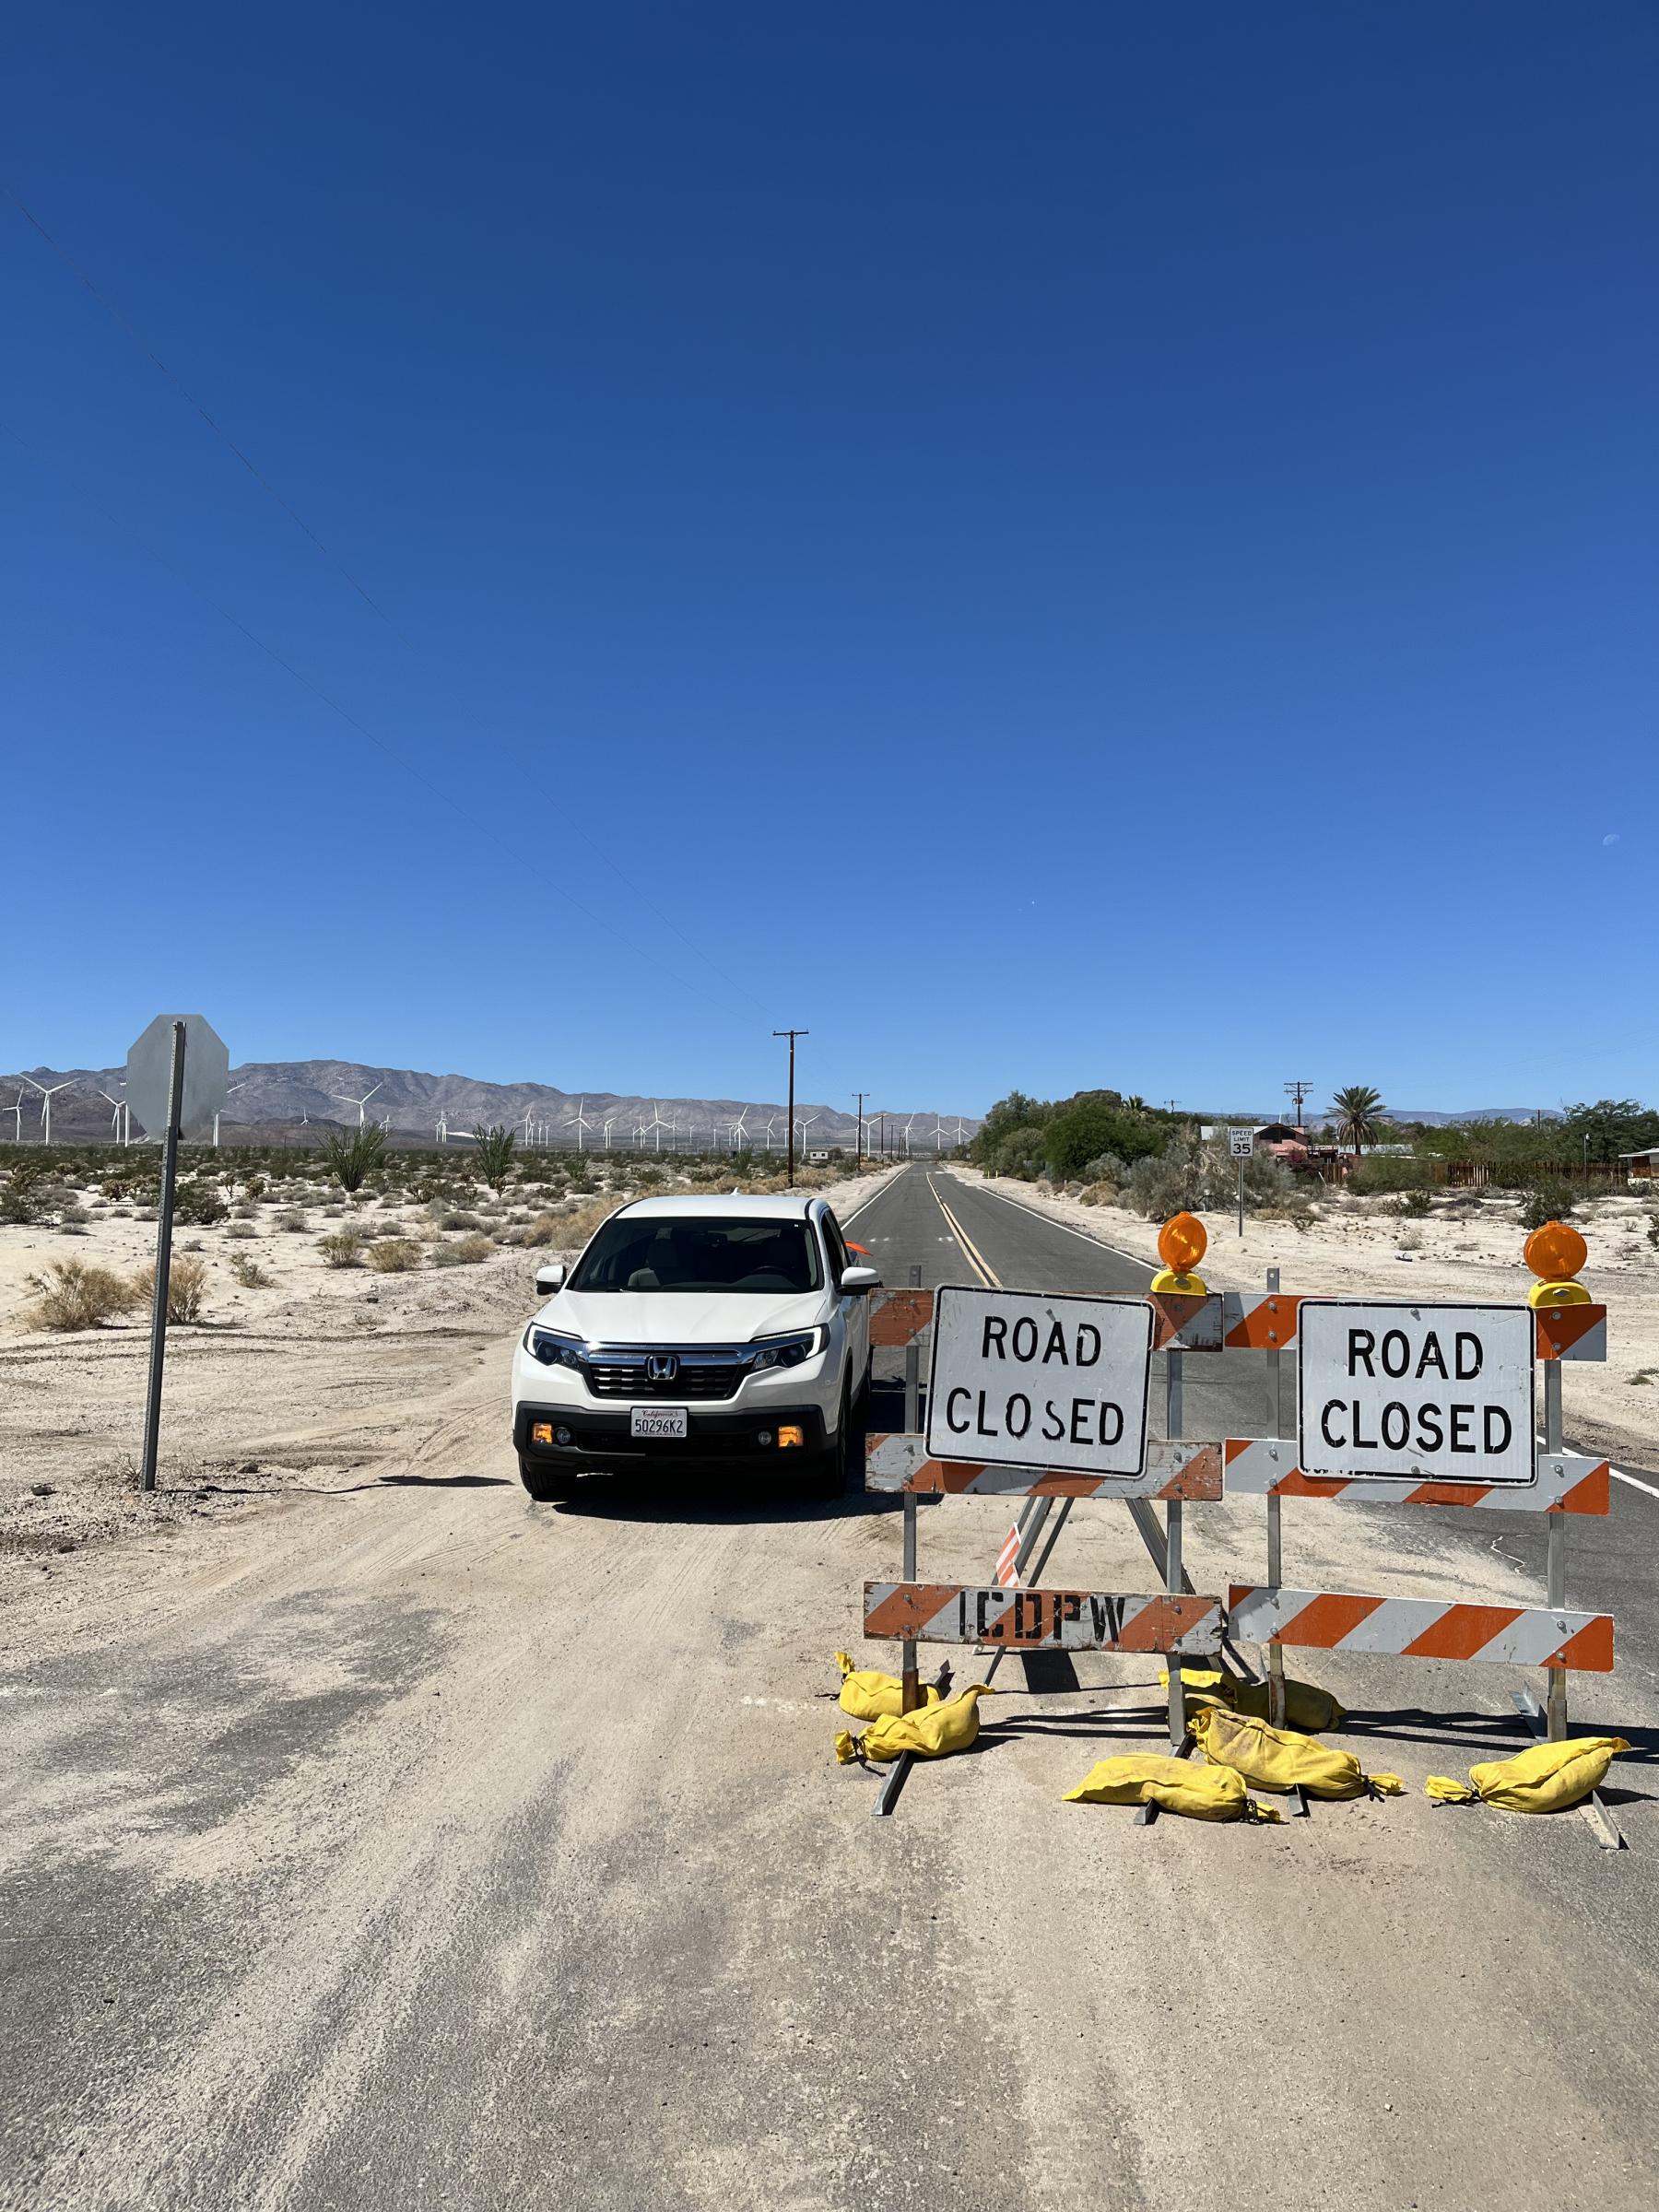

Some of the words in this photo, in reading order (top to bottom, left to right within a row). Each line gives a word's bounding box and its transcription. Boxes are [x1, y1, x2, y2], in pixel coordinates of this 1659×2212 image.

[1232, 1143, 1251, 1154] 35
[982, 1316, 1102, 1367] ROAD
[1347, 1328, 1484, 1381] ROAD
[635, 1419, 683, 1433] 50296K2
[946, 1386, 1124, 1446] CLOSED
[1321, 1398, 1512, 1454] CLOSED
